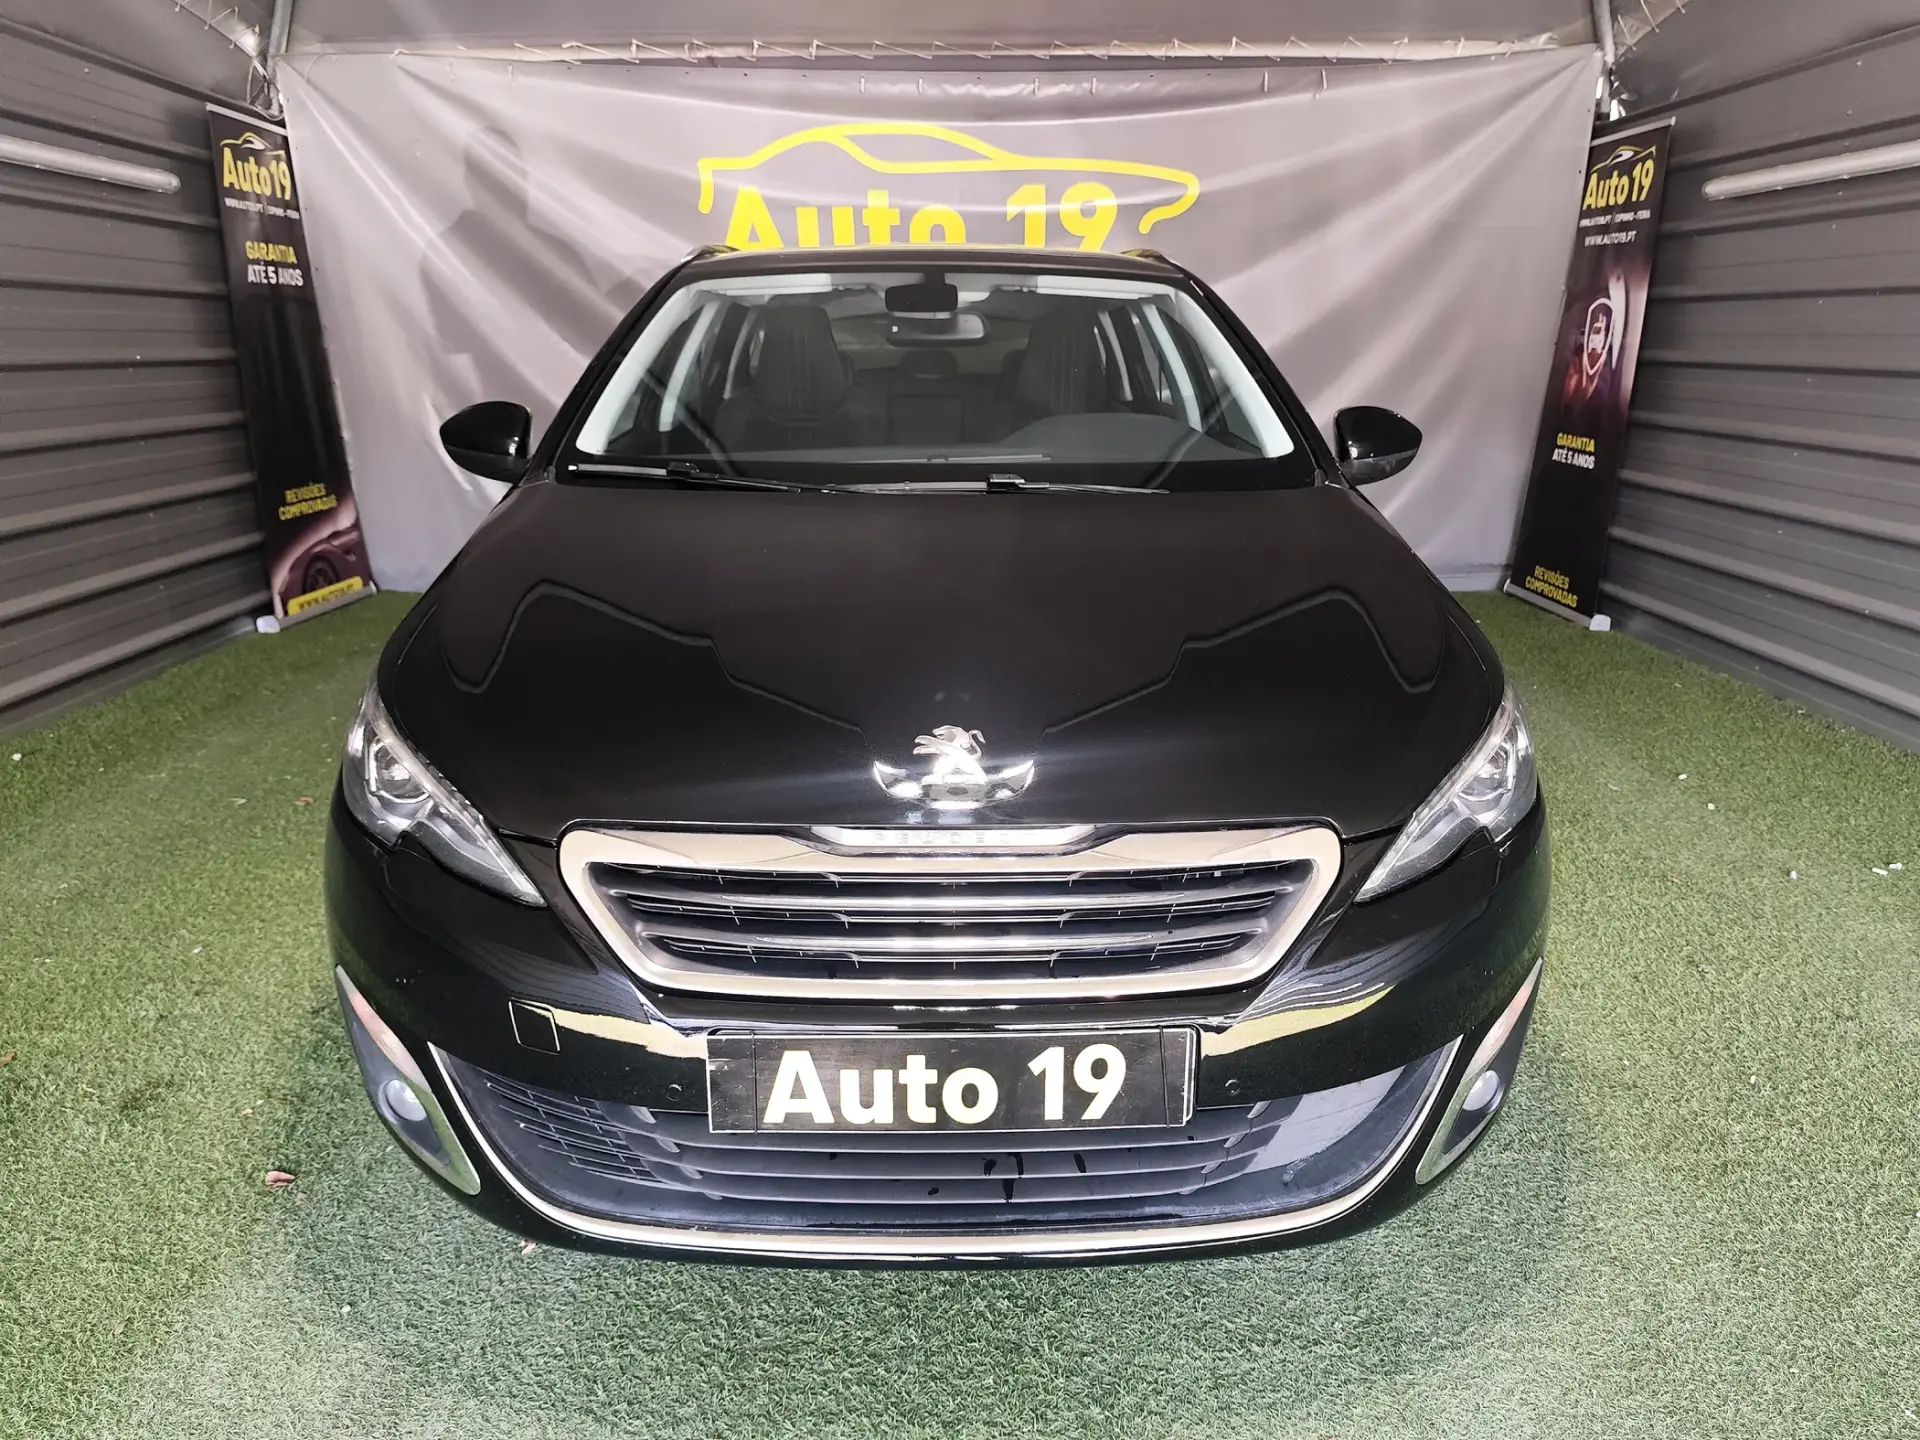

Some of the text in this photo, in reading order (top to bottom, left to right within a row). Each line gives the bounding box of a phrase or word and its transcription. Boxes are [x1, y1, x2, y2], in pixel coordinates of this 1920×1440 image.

[223, 147, 291, 200] Auto 19
[1582, 159, 1654, 210] Auto 19
[725, 181, 1118, 252] Auto 19
[245, 240, 298, 264] GARANTIA
[247, 261, 304, 286] ATÉ 5 ANOS
[1551, 447, 1595, 469] ATÉ 5 ANOS
[1556, 432, 1596, 453] GARANTIA
[1525, 576, 1577, 608] COMPROVADAS
[763, 1044, 1127, 1125] Auto 19
